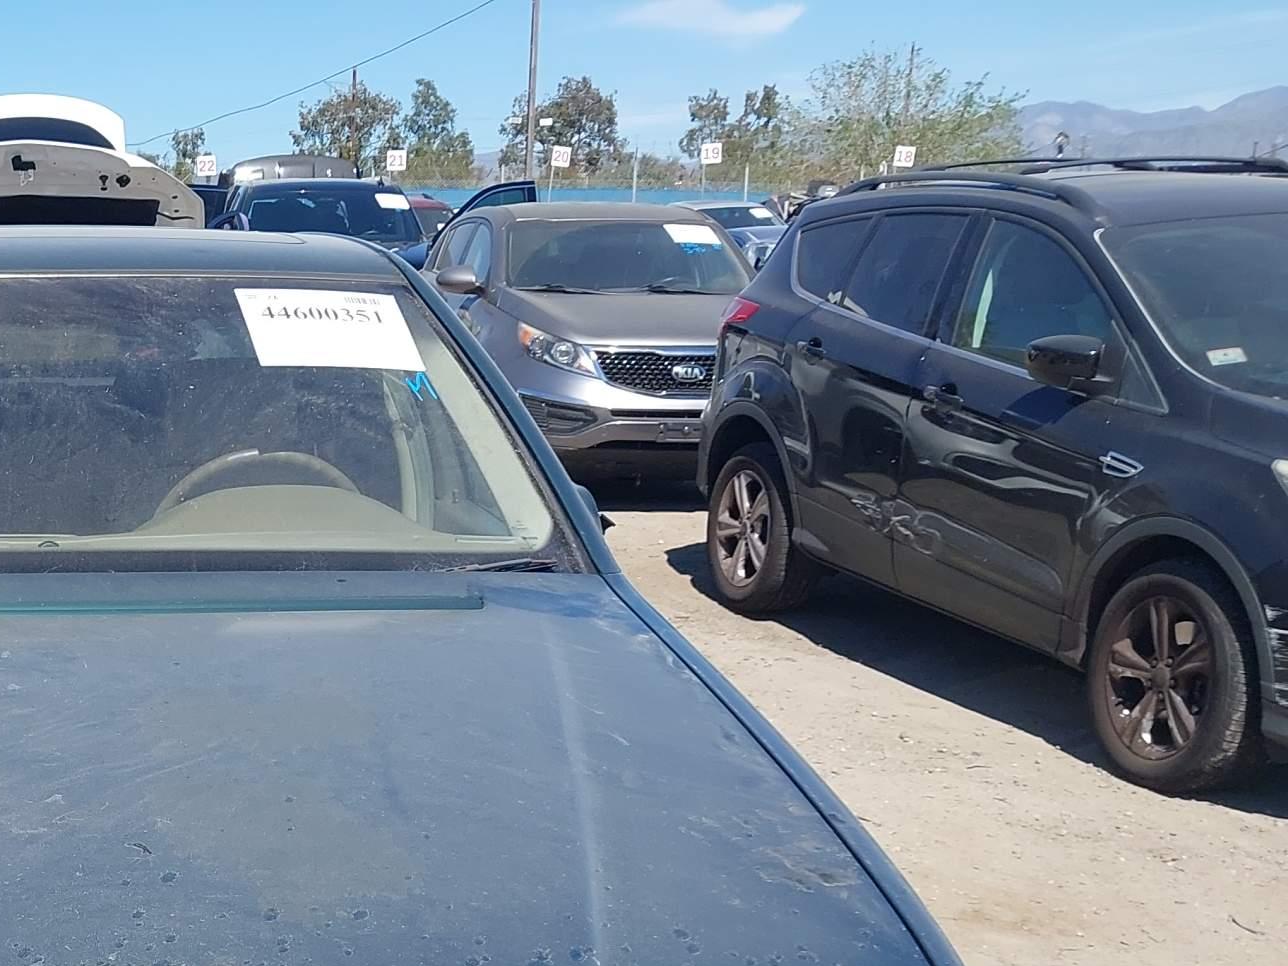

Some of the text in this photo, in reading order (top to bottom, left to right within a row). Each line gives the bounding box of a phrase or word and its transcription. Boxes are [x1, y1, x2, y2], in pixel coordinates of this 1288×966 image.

[554, 150, 570, 163] 20
[703, 147, 720, 160] 19
[895, 150, 913, 163] 18
[199, 160, 215, 173] 22
[389, 154, 404, 167] 21
[261, 306, 383, 324] 44600351
[679, 367, 700, 378] KIA
